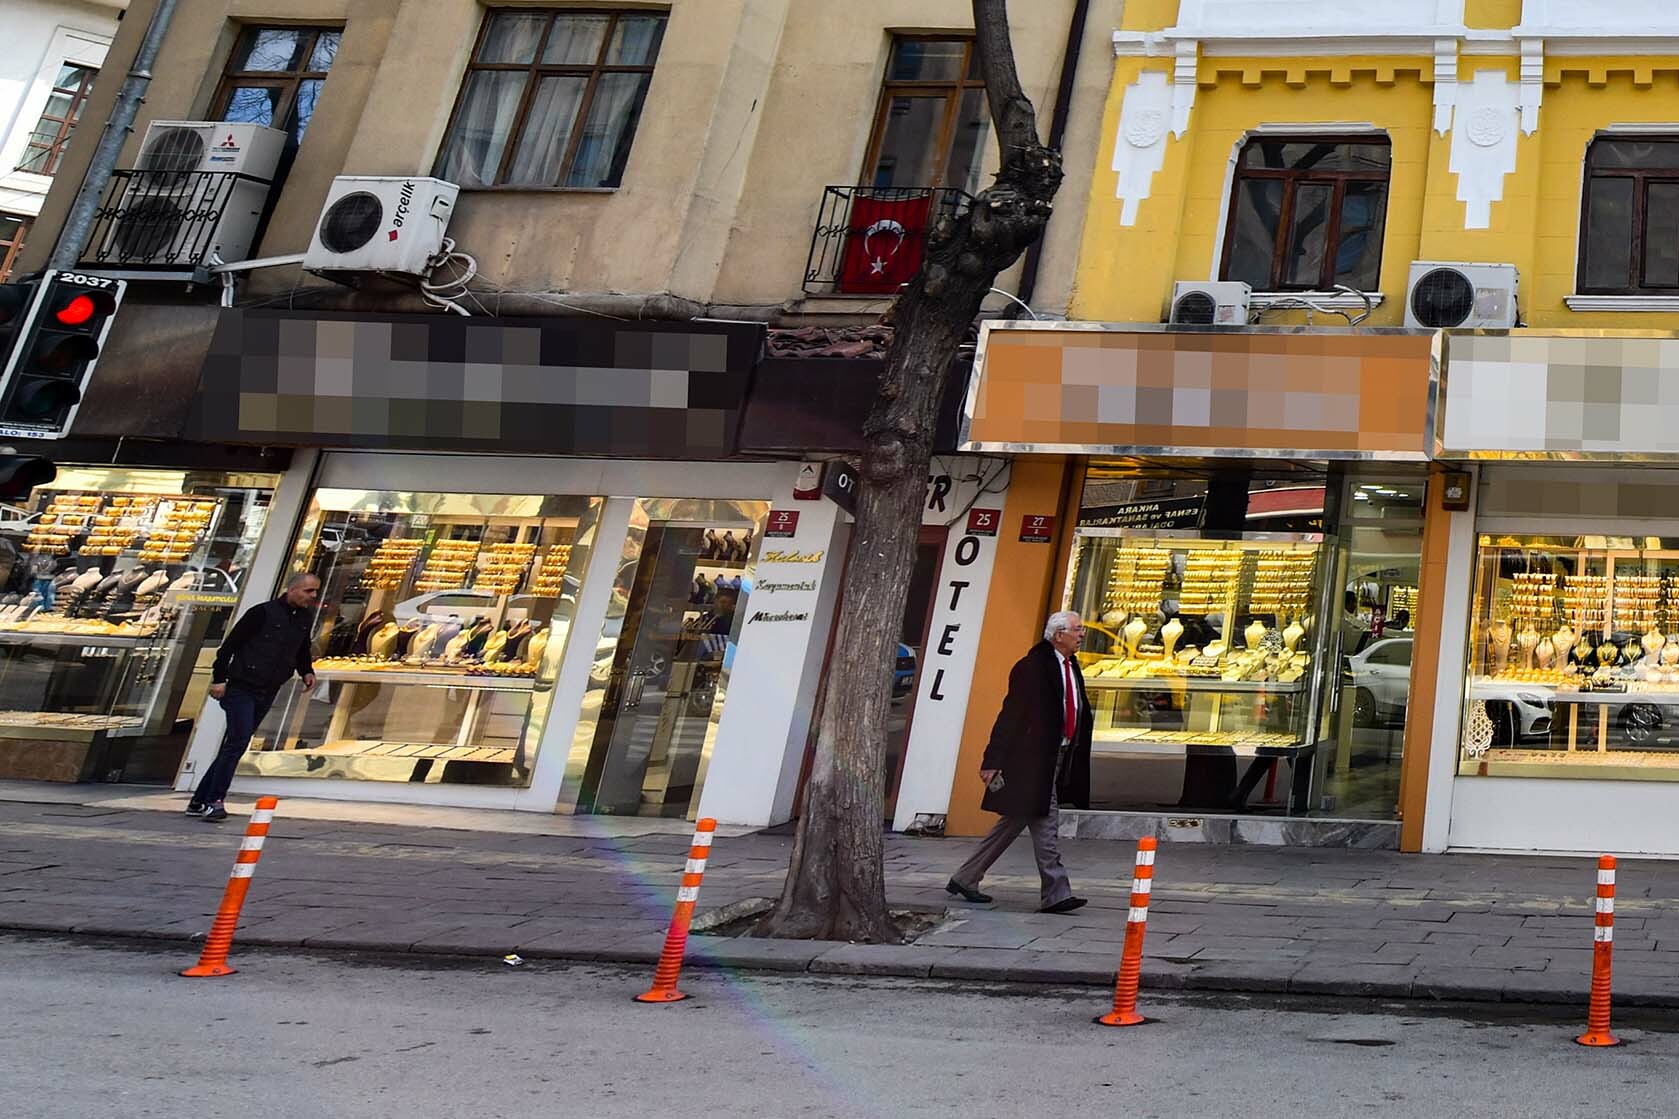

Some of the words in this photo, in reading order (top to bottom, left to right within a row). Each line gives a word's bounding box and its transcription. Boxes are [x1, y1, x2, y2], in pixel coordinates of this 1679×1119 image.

[392, 179, 415, 228] arçelik
[60, 272, 112, 289] 2037
[778, 512, 790, 522] 25
[976, 513, 991, 526] 25
[1032, 516, 1045, 526] 27
[930, 536, 980, 701] OTEL
